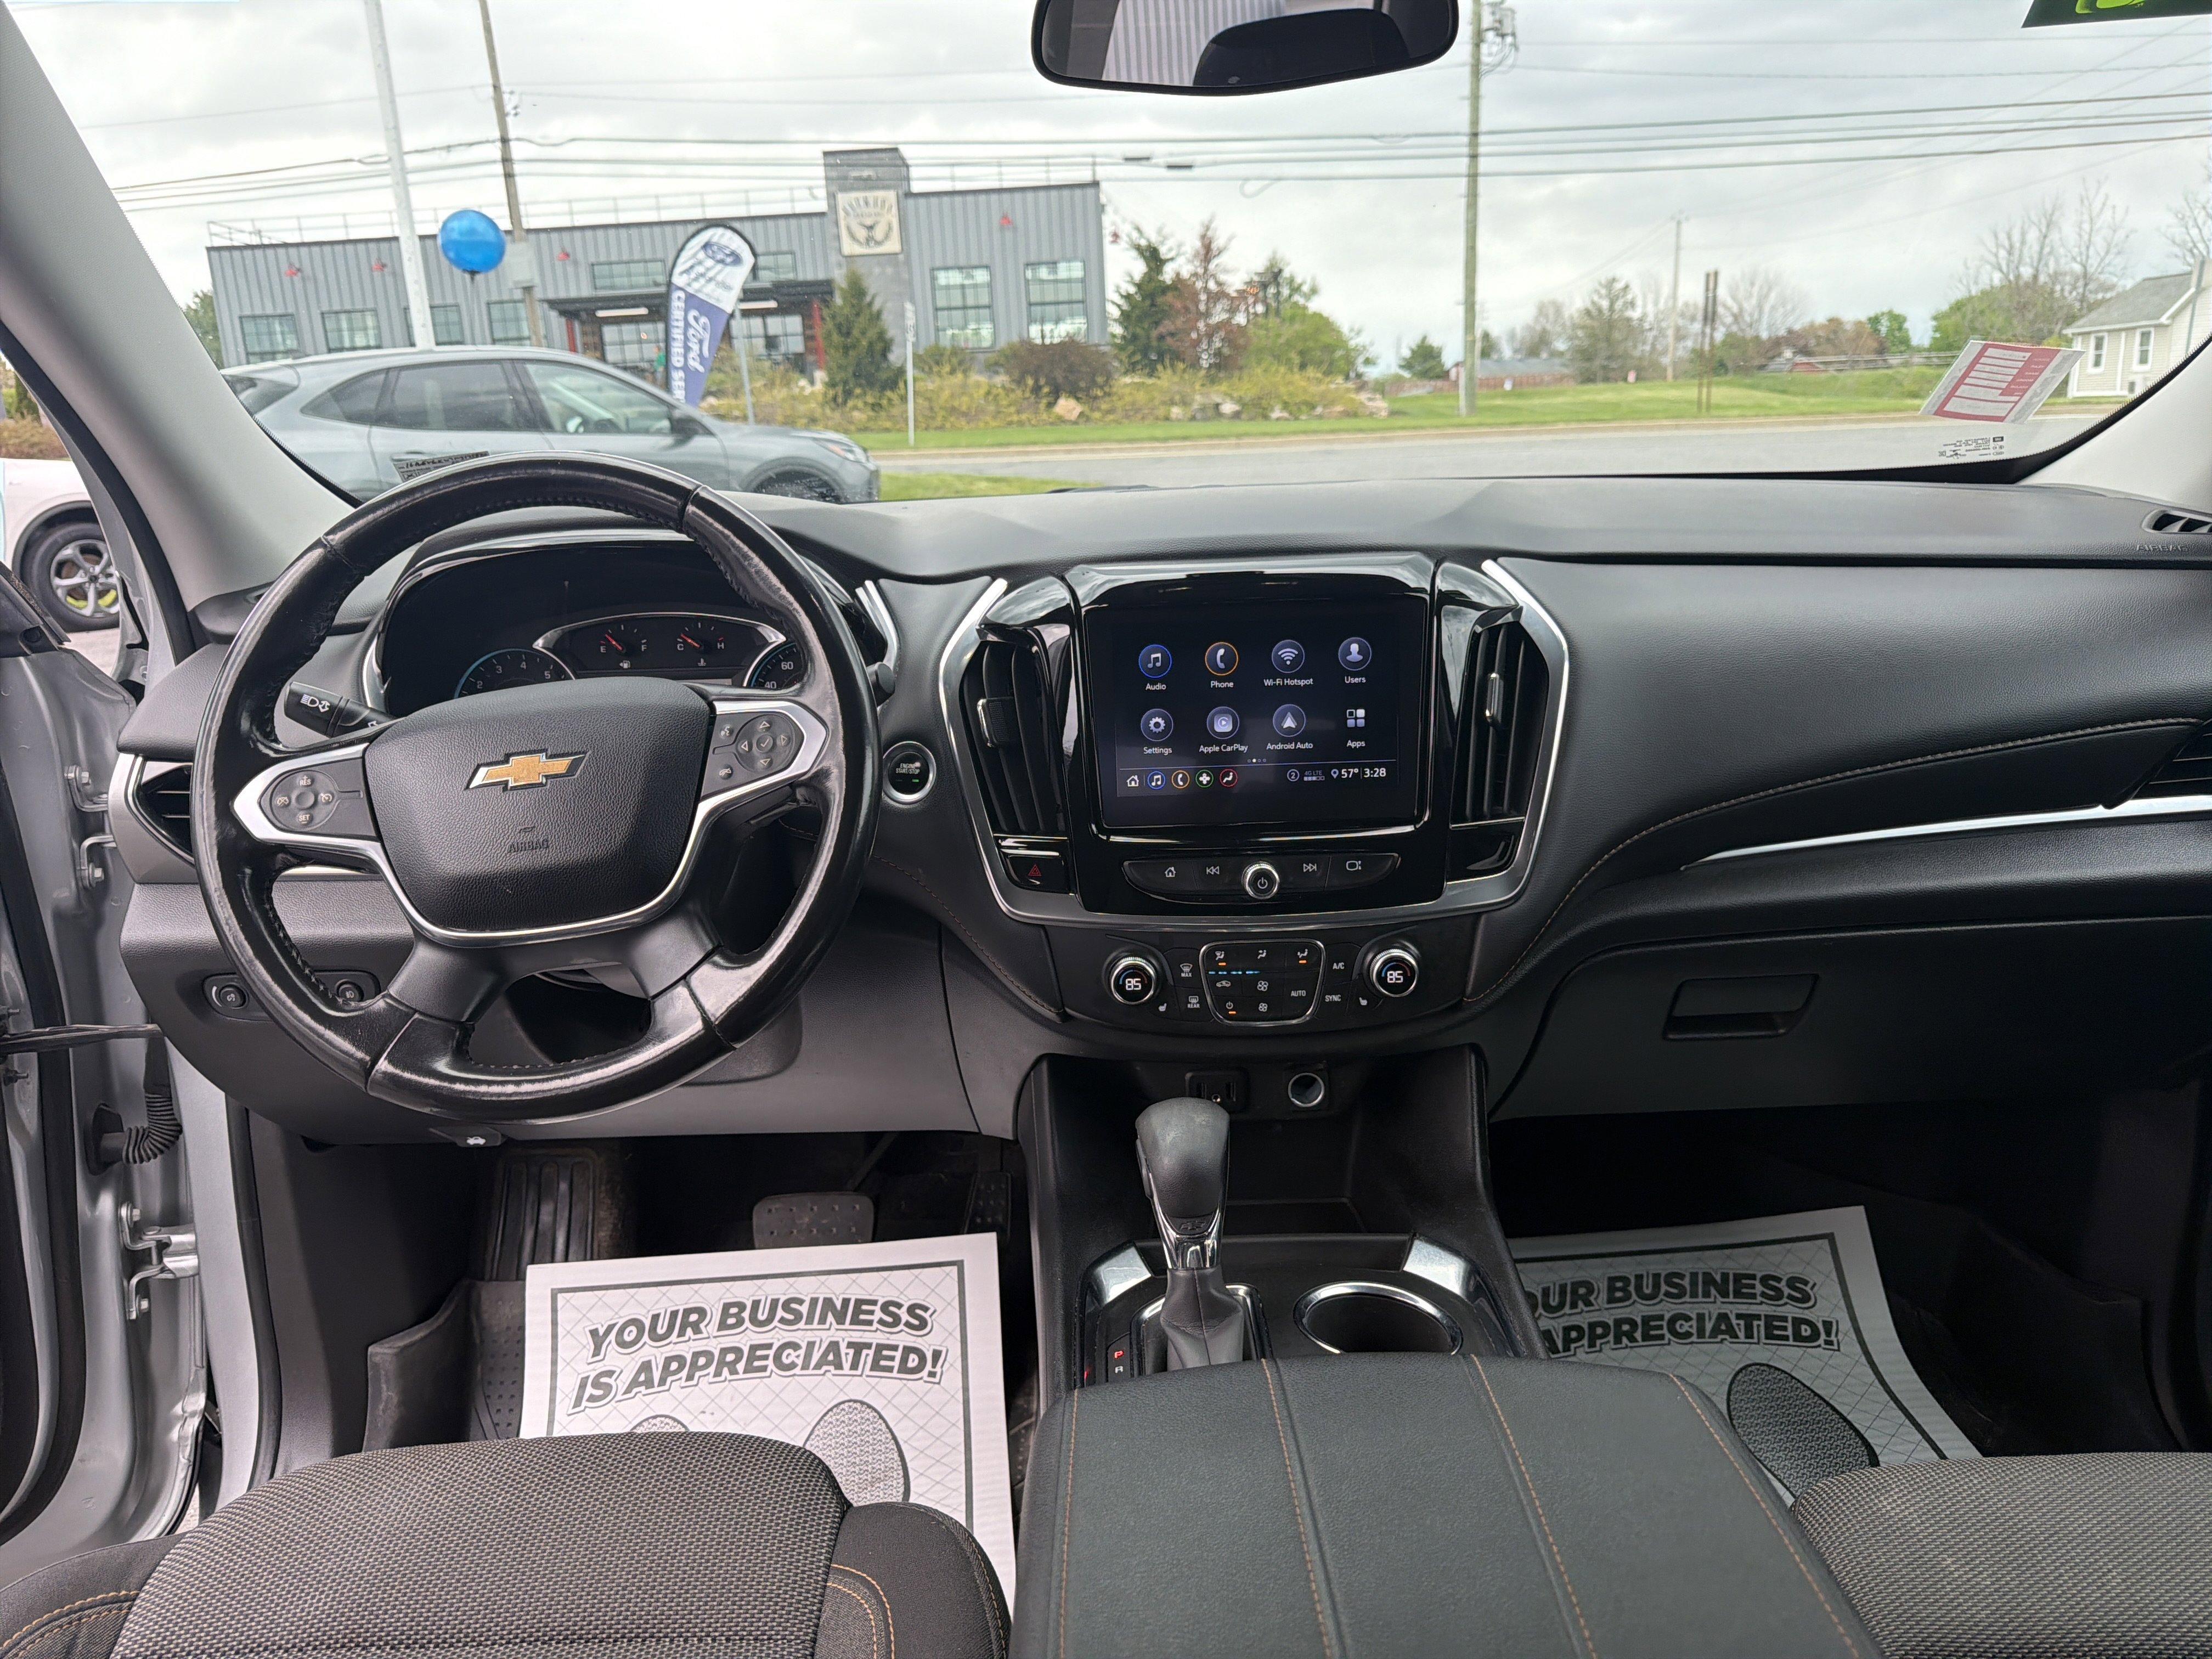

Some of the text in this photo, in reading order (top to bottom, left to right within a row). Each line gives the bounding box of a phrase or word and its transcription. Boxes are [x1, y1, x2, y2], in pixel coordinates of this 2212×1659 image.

[687, 309, 710, 374] Ford
[670, 290, 686, 404] CERTIFIED SER
[781, 662, 794, 670] 60
[477, 681, 483, 689] 2
[764, 681, 777, 689] 40
[1284, 678, 1313, 686] Hotspot
[1266, 742, 1295, 750] Android
[1346, 740, 1365, 748] Apps
[1143, 747, 1172, 755] Settings
[1199, 744, 1248, 754] Apple CarPlay
[1363, 768, 1386, 777] 3:28
[508, 839, 549, 853] AIRBAG
[1387, 970, 1403, 983] 85
[1126, 978, 1142, 990] 85
[1606, 1271, 1814, 1305] BUSINESS
[586, 1296, 934, 1359] YOUR BUSINESS
[1114, 1350, 1124, 1359] P
[572, 1340, 946, 1409] IS APPRECIATED!
